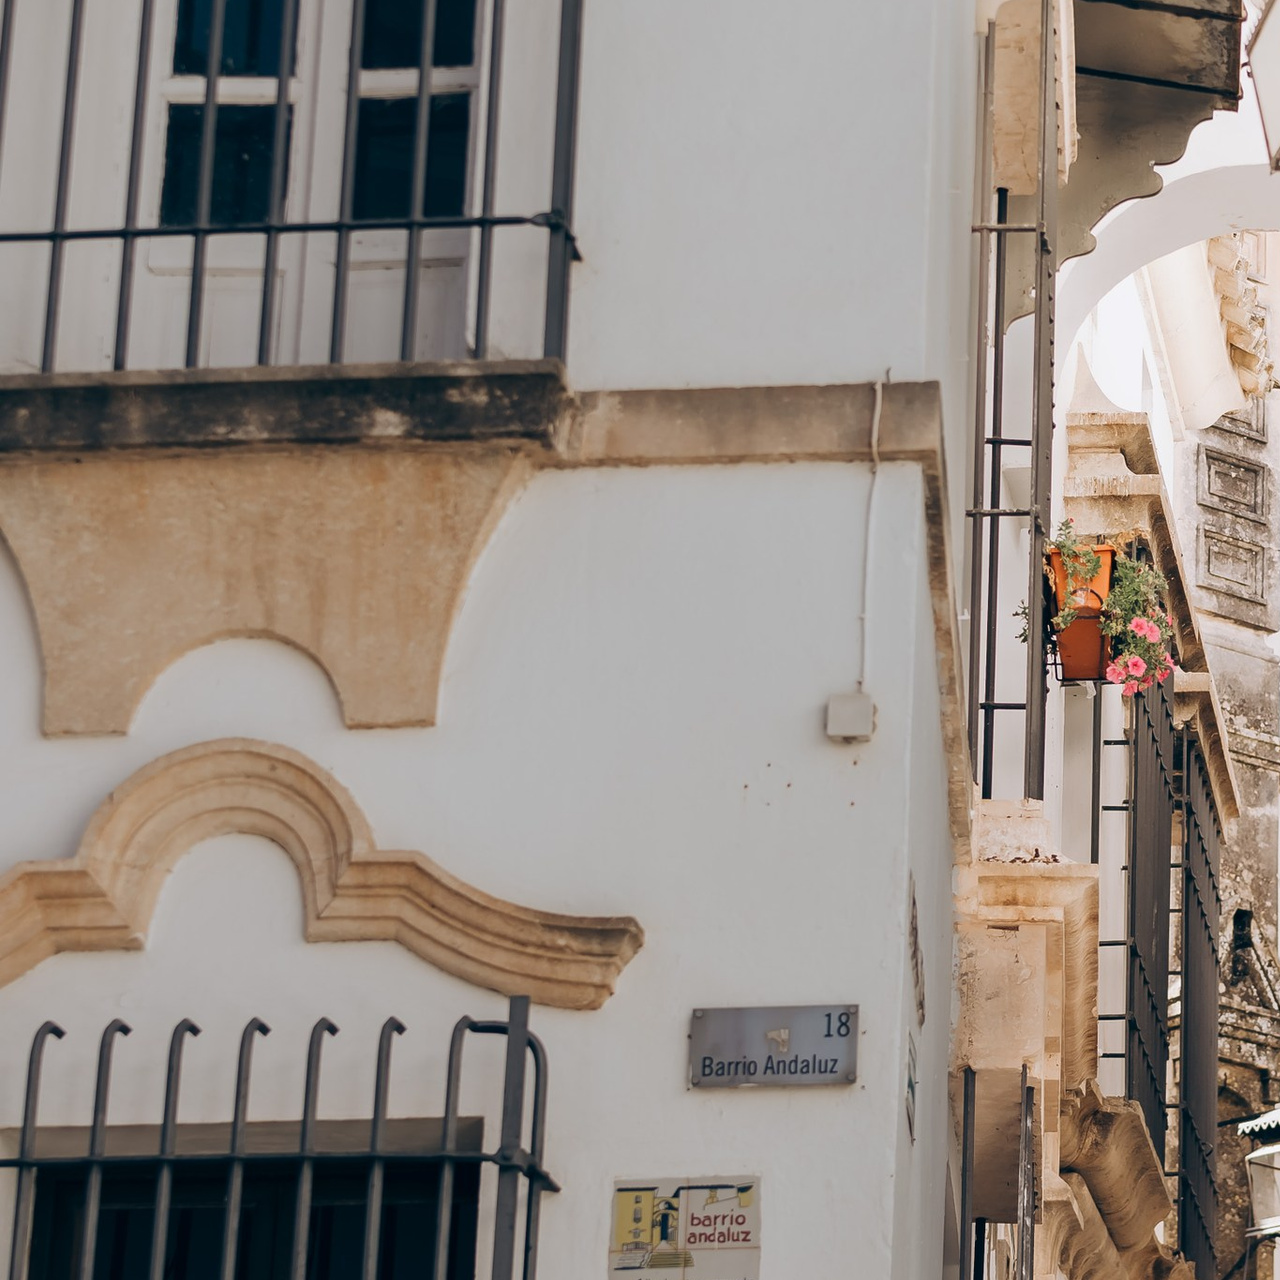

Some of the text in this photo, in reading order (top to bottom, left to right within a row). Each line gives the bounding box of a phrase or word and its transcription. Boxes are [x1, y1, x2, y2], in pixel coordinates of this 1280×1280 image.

[824, 1012, 851, 1038] 18
[702, 1054, 838, 1077] Barrio Andaluz
[690, 1208, 746, 1227] barrio
[687, 1226, 752, 1244] andaluz
